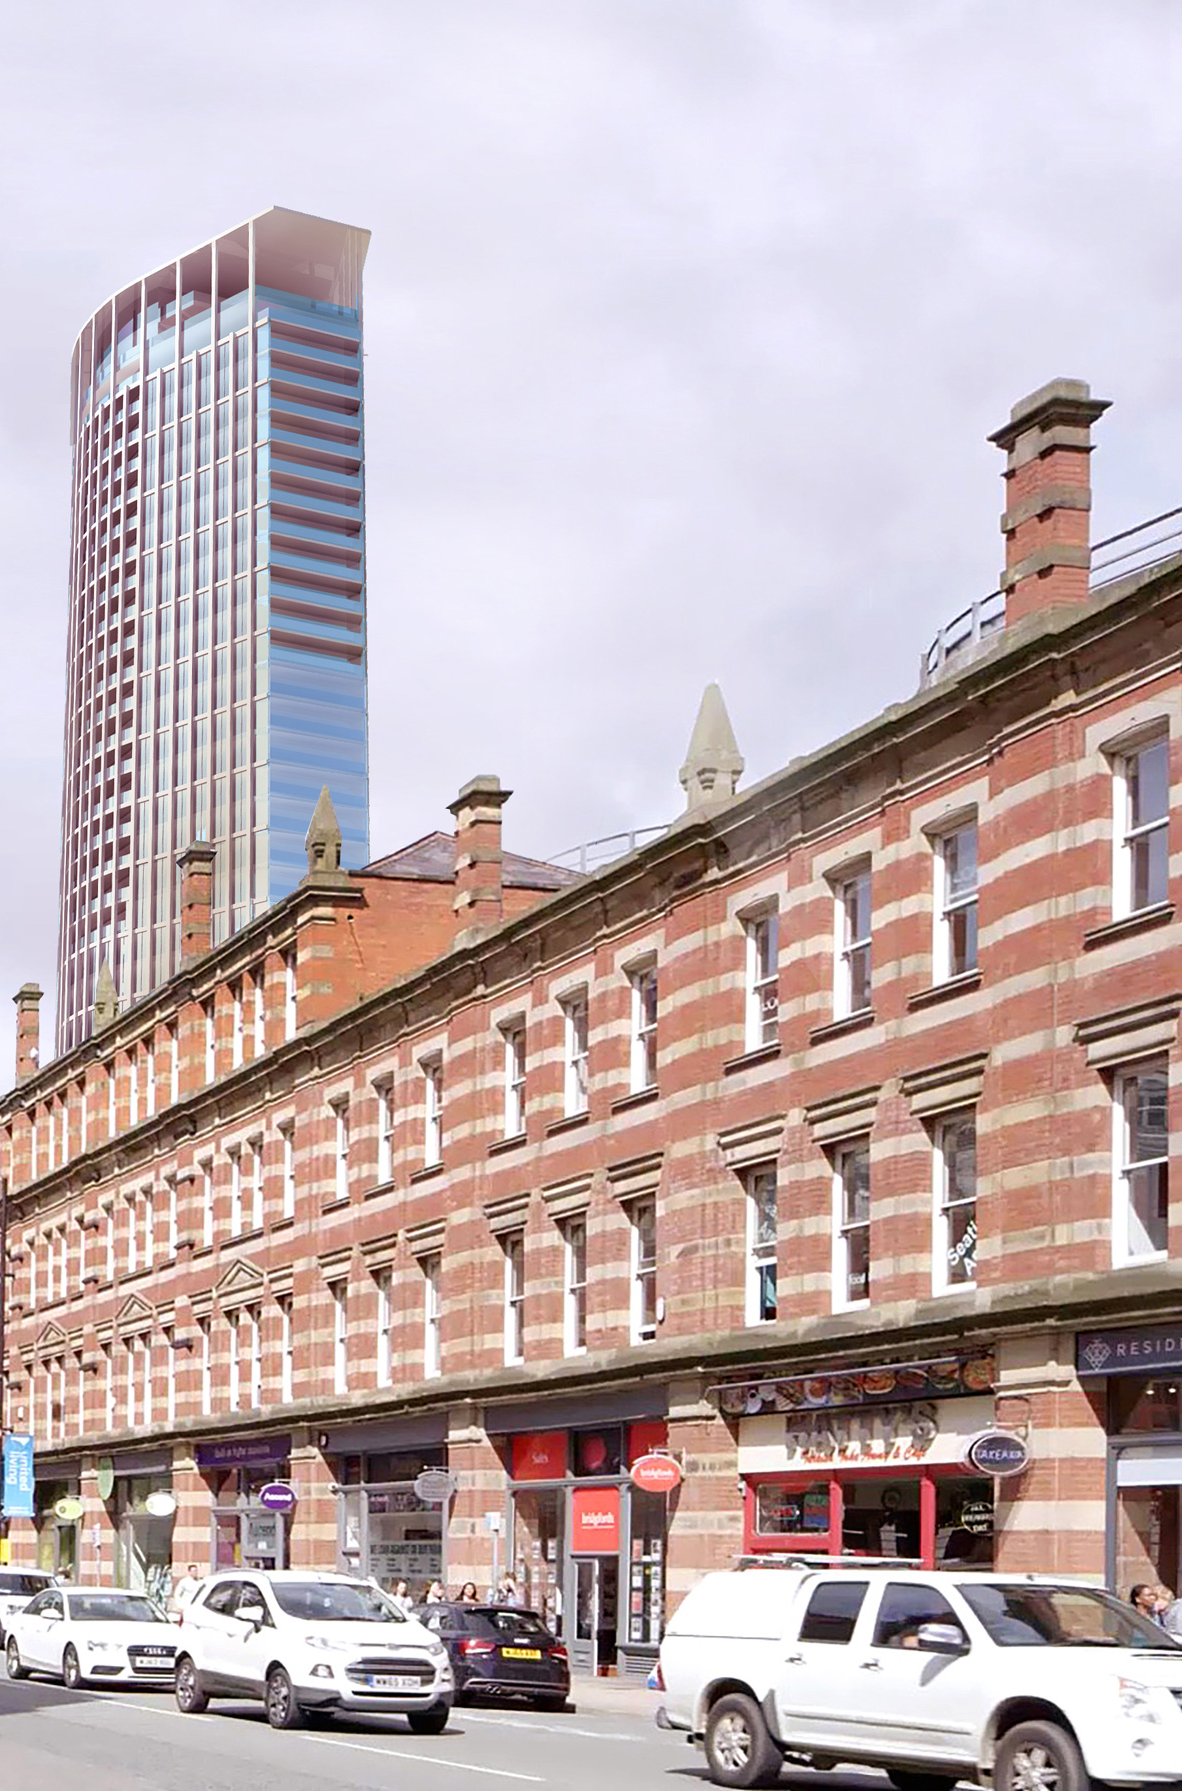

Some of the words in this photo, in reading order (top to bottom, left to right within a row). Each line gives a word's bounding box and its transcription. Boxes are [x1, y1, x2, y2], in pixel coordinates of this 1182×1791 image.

[1117, 1337, 1182, 1357] RESID
[6, 1451, 19, 1485] living
[19, 1451, 32, 1491] united
[581, 1512, 615, 1526] bridgfords
